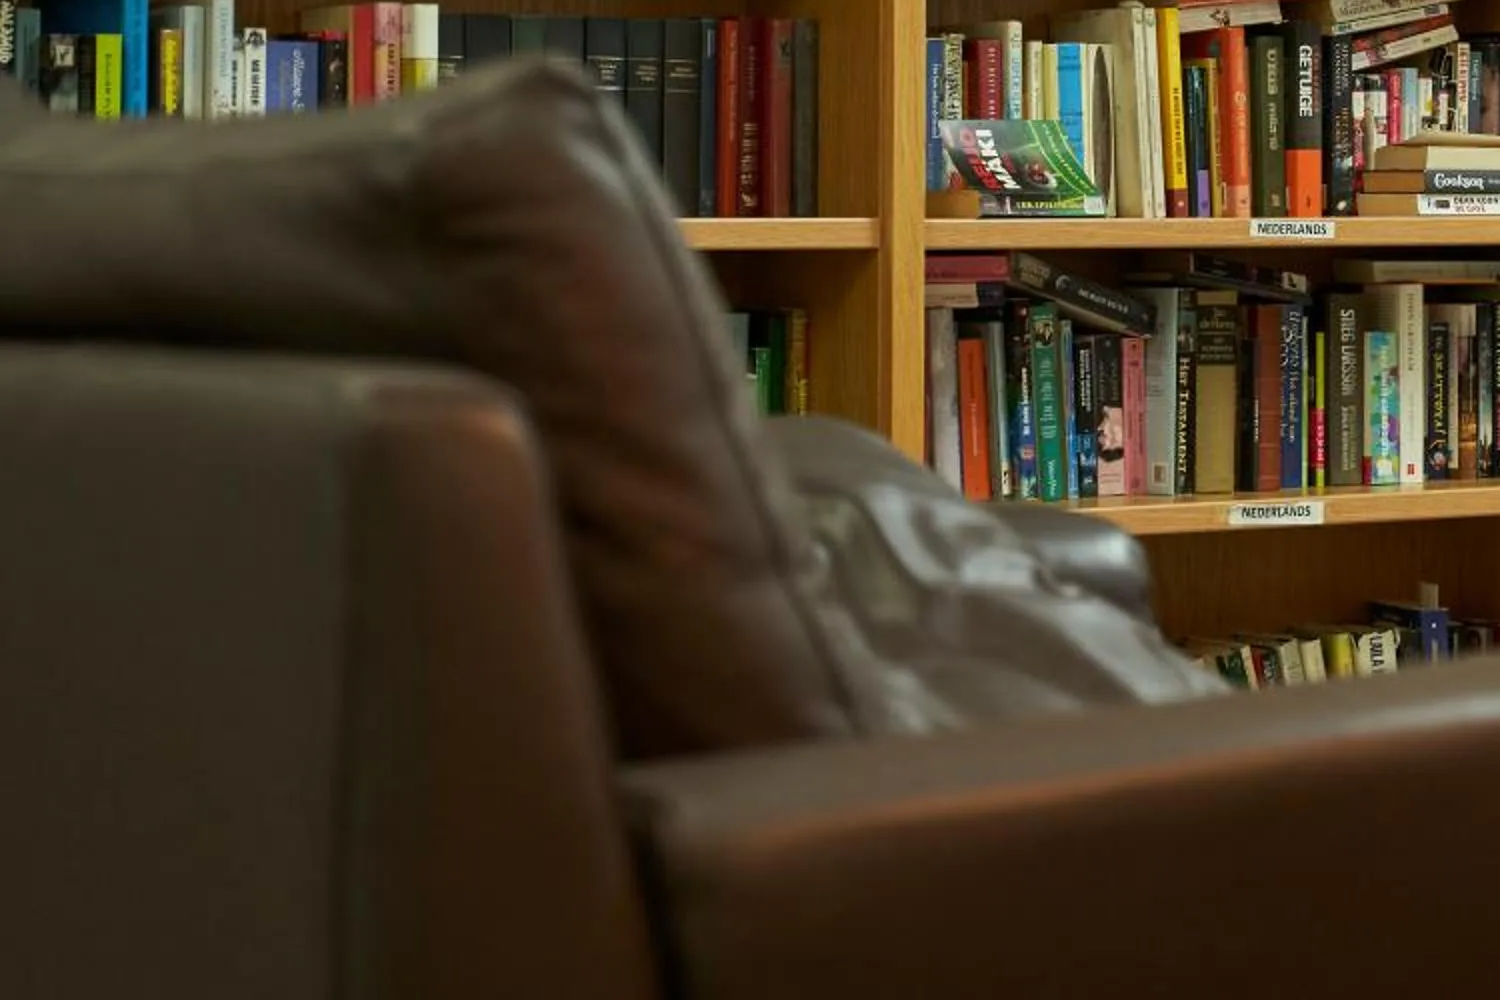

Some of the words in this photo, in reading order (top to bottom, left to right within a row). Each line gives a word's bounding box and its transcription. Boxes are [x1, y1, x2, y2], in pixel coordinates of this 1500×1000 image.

[1299, 44, 1313, 117] GETUIGE
[976, 129, 1021, 190] MÄKI
[1434, 173, 1484, 190] Cookson
[1257, 222, 1327, 237] NEDERLANDS
[1340, 309, 1355, 342] STIEG
[1340, 343, 1356, 397] LARSSON
[1177, 387, 1191, 474] TESTAMENT
[1241, 505, 1311, 519] NEDERLANDS
